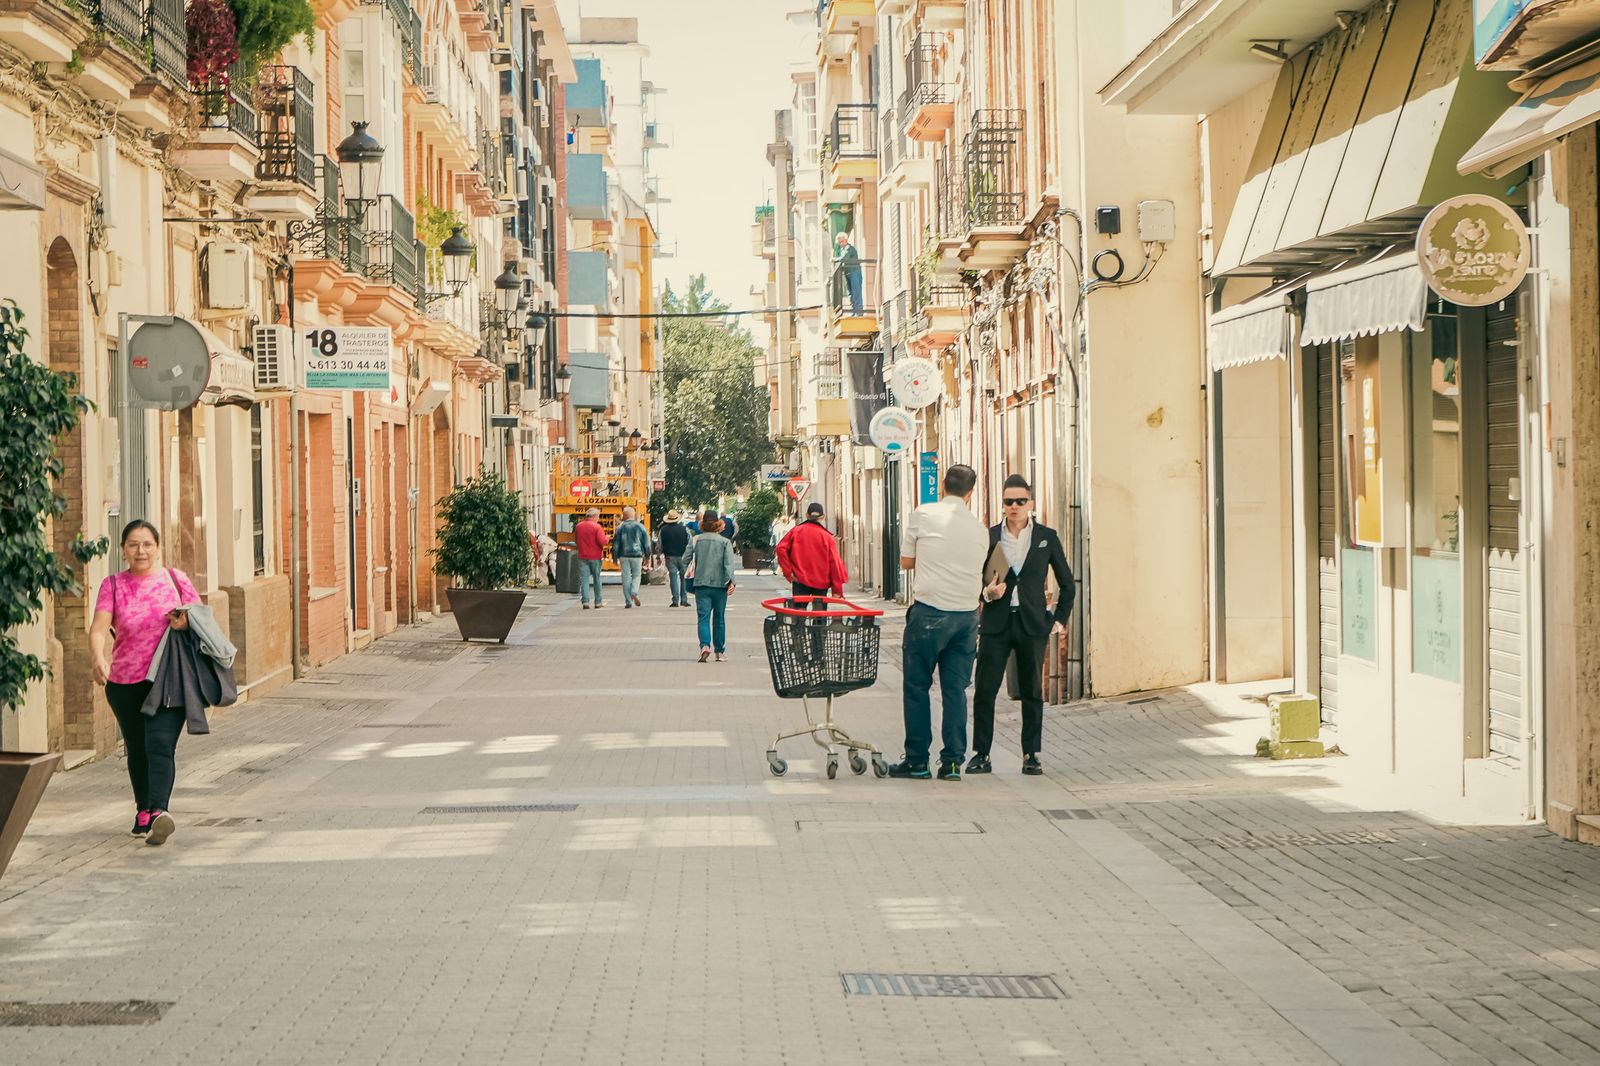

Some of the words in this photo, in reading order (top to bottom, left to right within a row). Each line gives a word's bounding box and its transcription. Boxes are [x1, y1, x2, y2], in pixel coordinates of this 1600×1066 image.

[305, 329, 338, 356] 18
[317, 360, 337, 370] 613
[341, 360, 353, 370] 30
[357, 360, 370, 370] 44
[373, 360, 386, 370] 48
